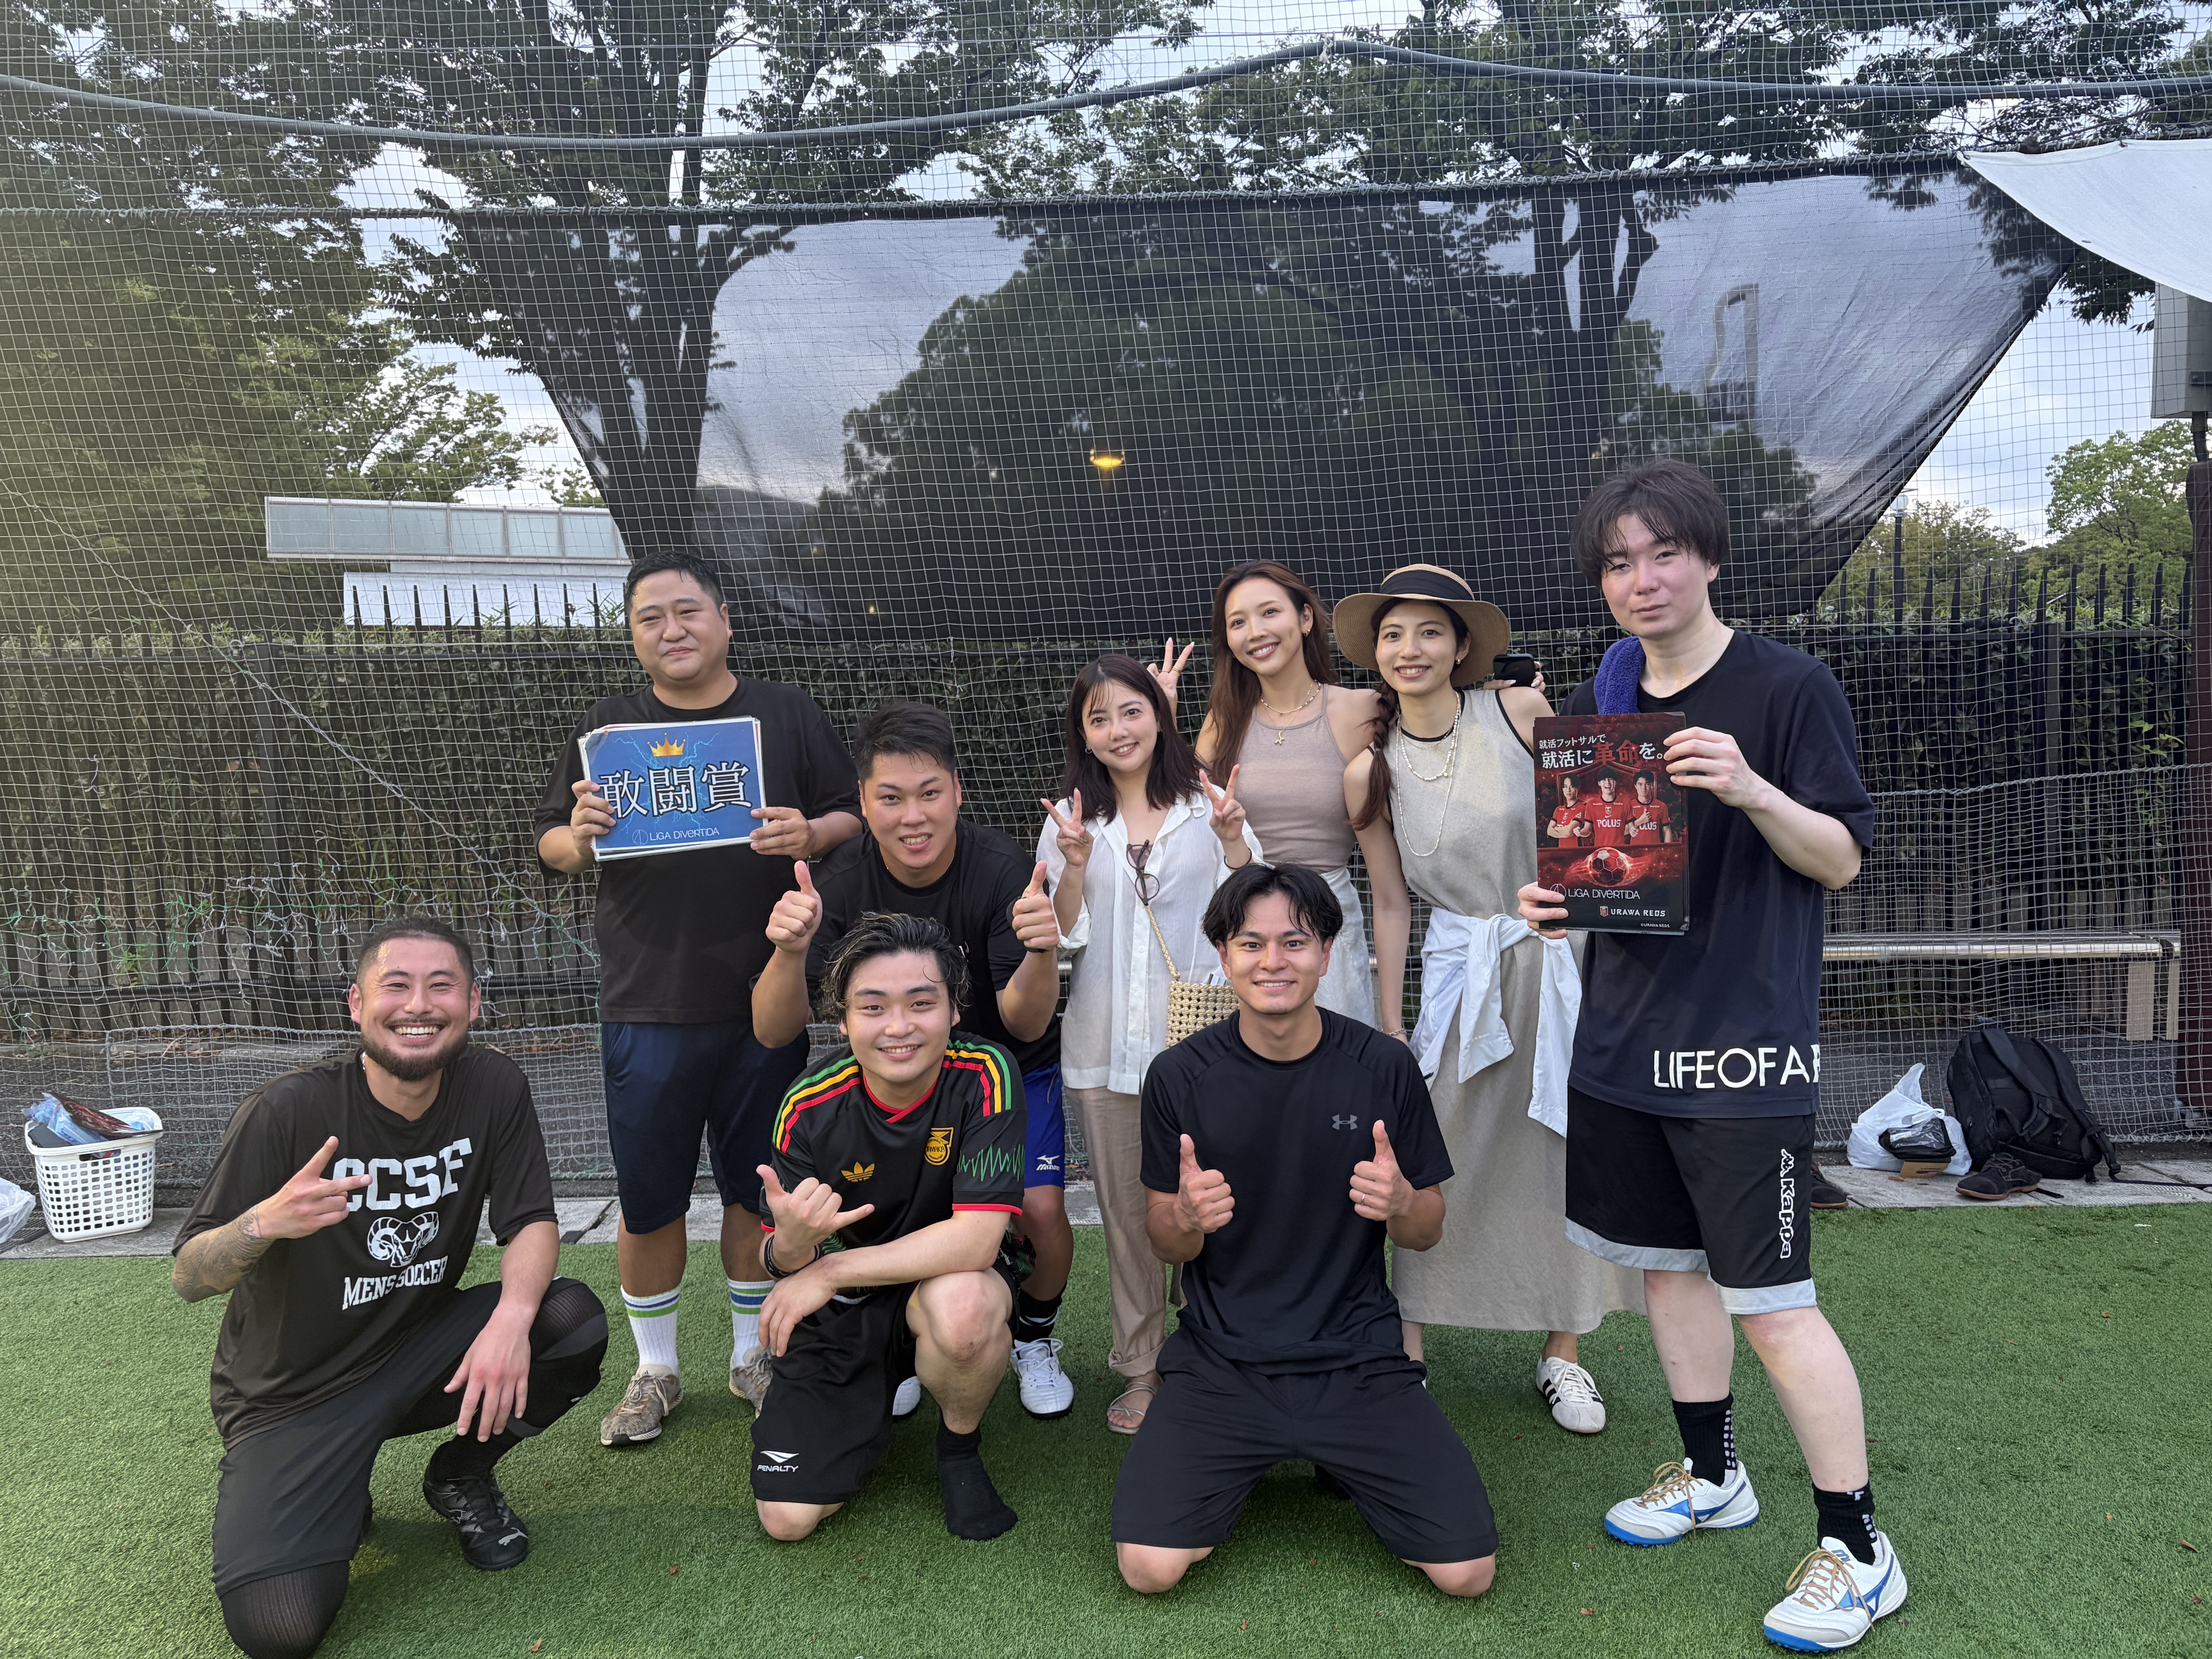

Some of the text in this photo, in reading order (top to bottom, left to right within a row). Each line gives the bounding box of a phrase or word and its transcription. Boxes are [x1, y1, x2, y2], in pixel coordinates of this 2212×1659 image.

[1539, 734, 1606, 749] 就活フットサルで
[1541, 739, 1663, 769] 就活に革命を。
[599, 760, 753, 818] 敢闘賞
[1597, 819, 1621, 828] POLUS
[1639, 821, 1657, 830] OLUS
[332, 1137, 472, 1212] CCSF
[1779, 1178, 1795, 1259] Kappa
[342, 1255, 448, 1310] MENS SOCCER
